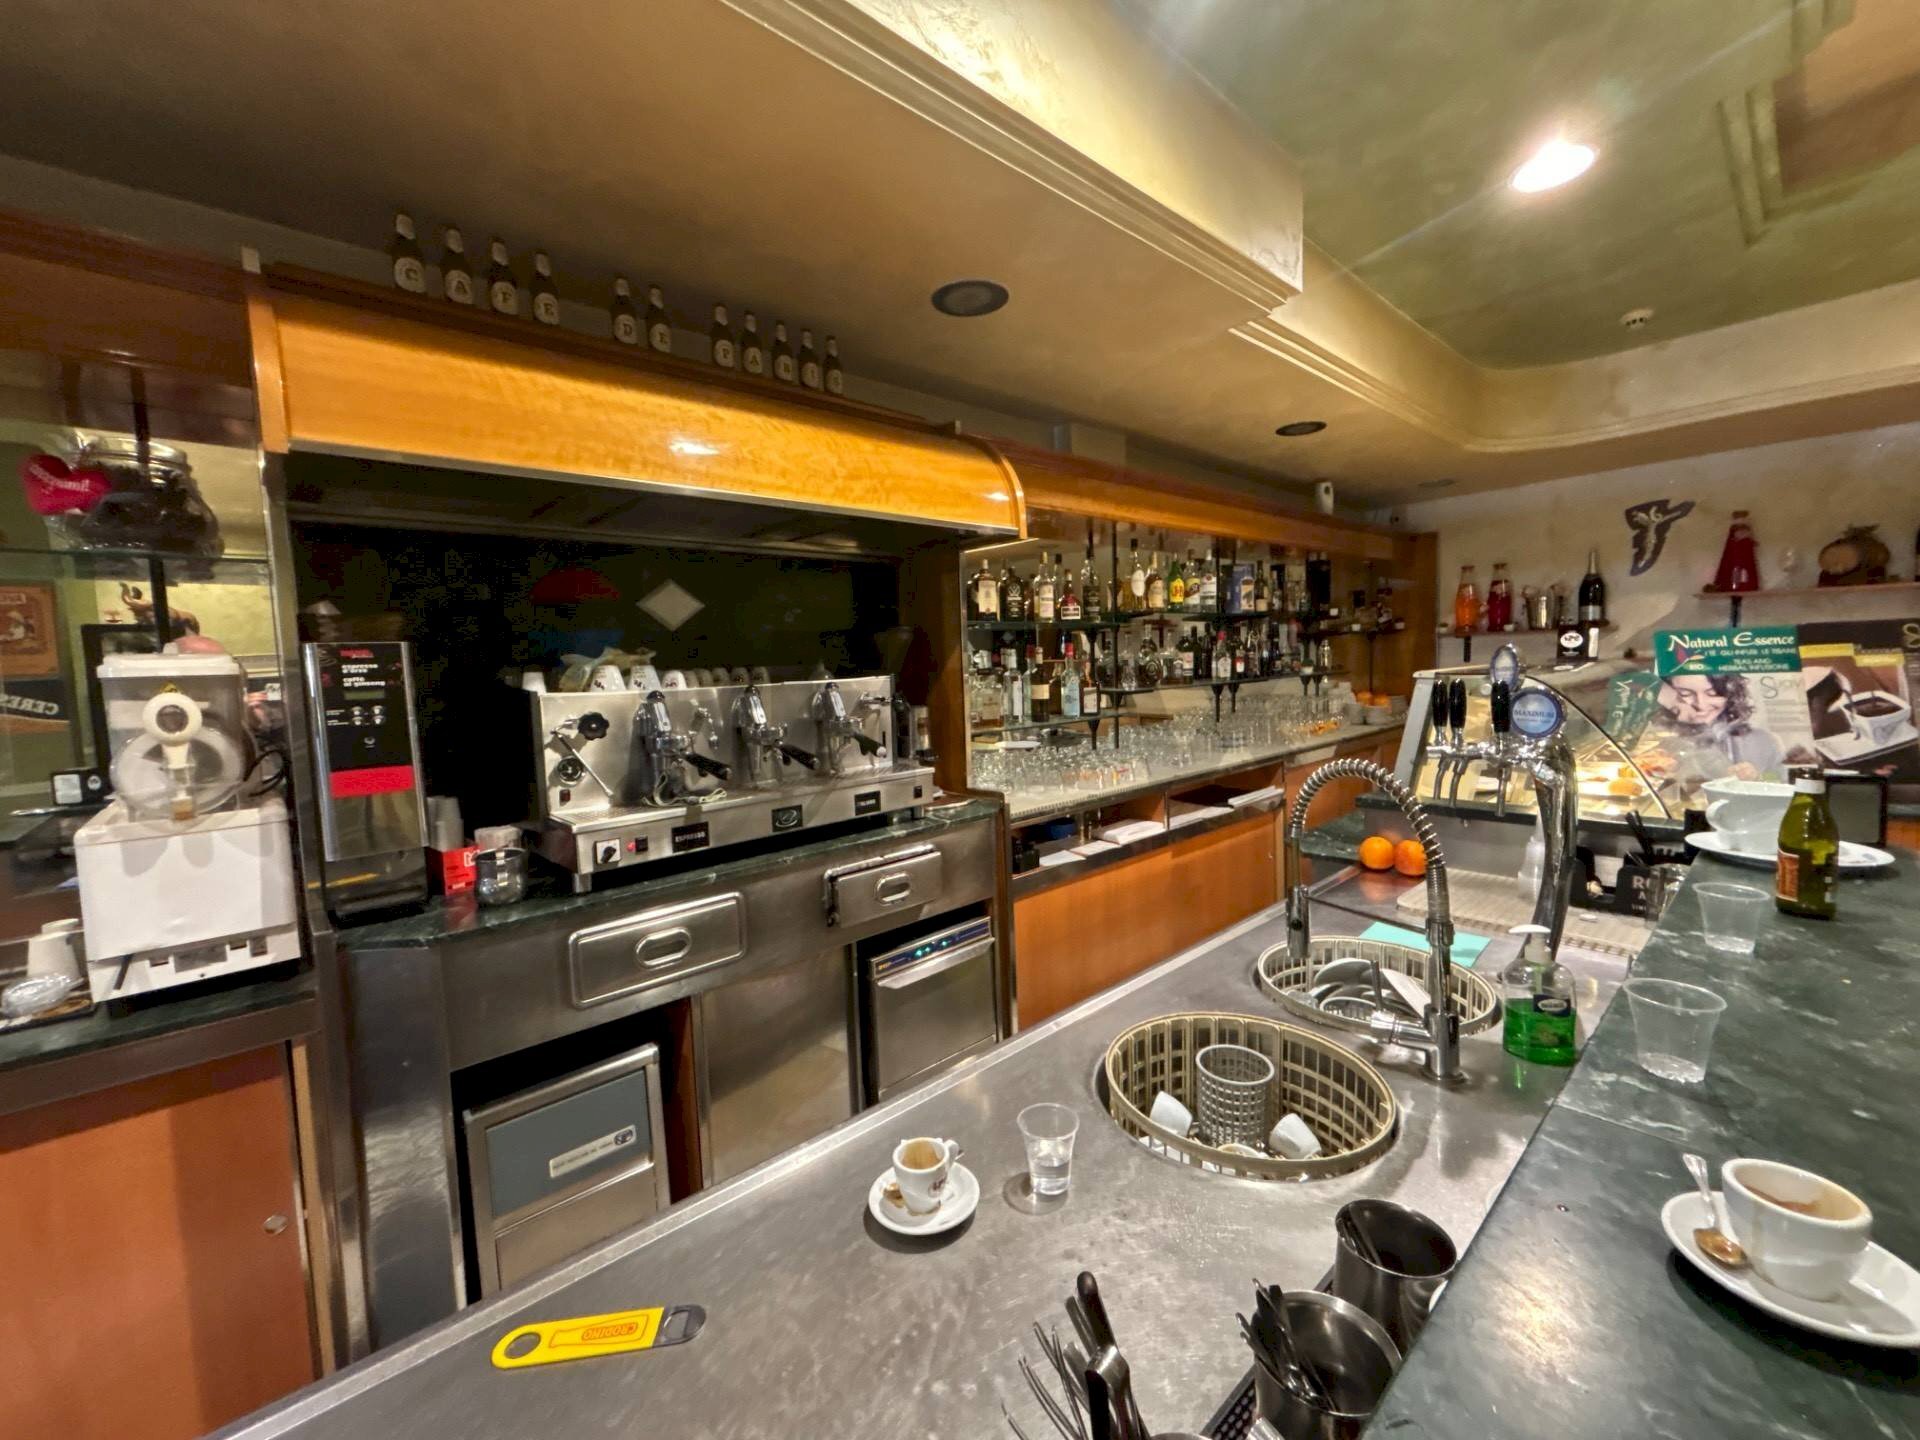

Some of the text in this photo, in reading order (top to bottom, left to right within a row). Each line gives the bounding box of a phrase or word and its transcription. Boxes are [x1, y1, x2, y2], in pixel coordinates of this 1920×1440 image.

[1668, 632, 1795, 651] Natural Essence
[583, 1323, 637, 1340] CRODINO
